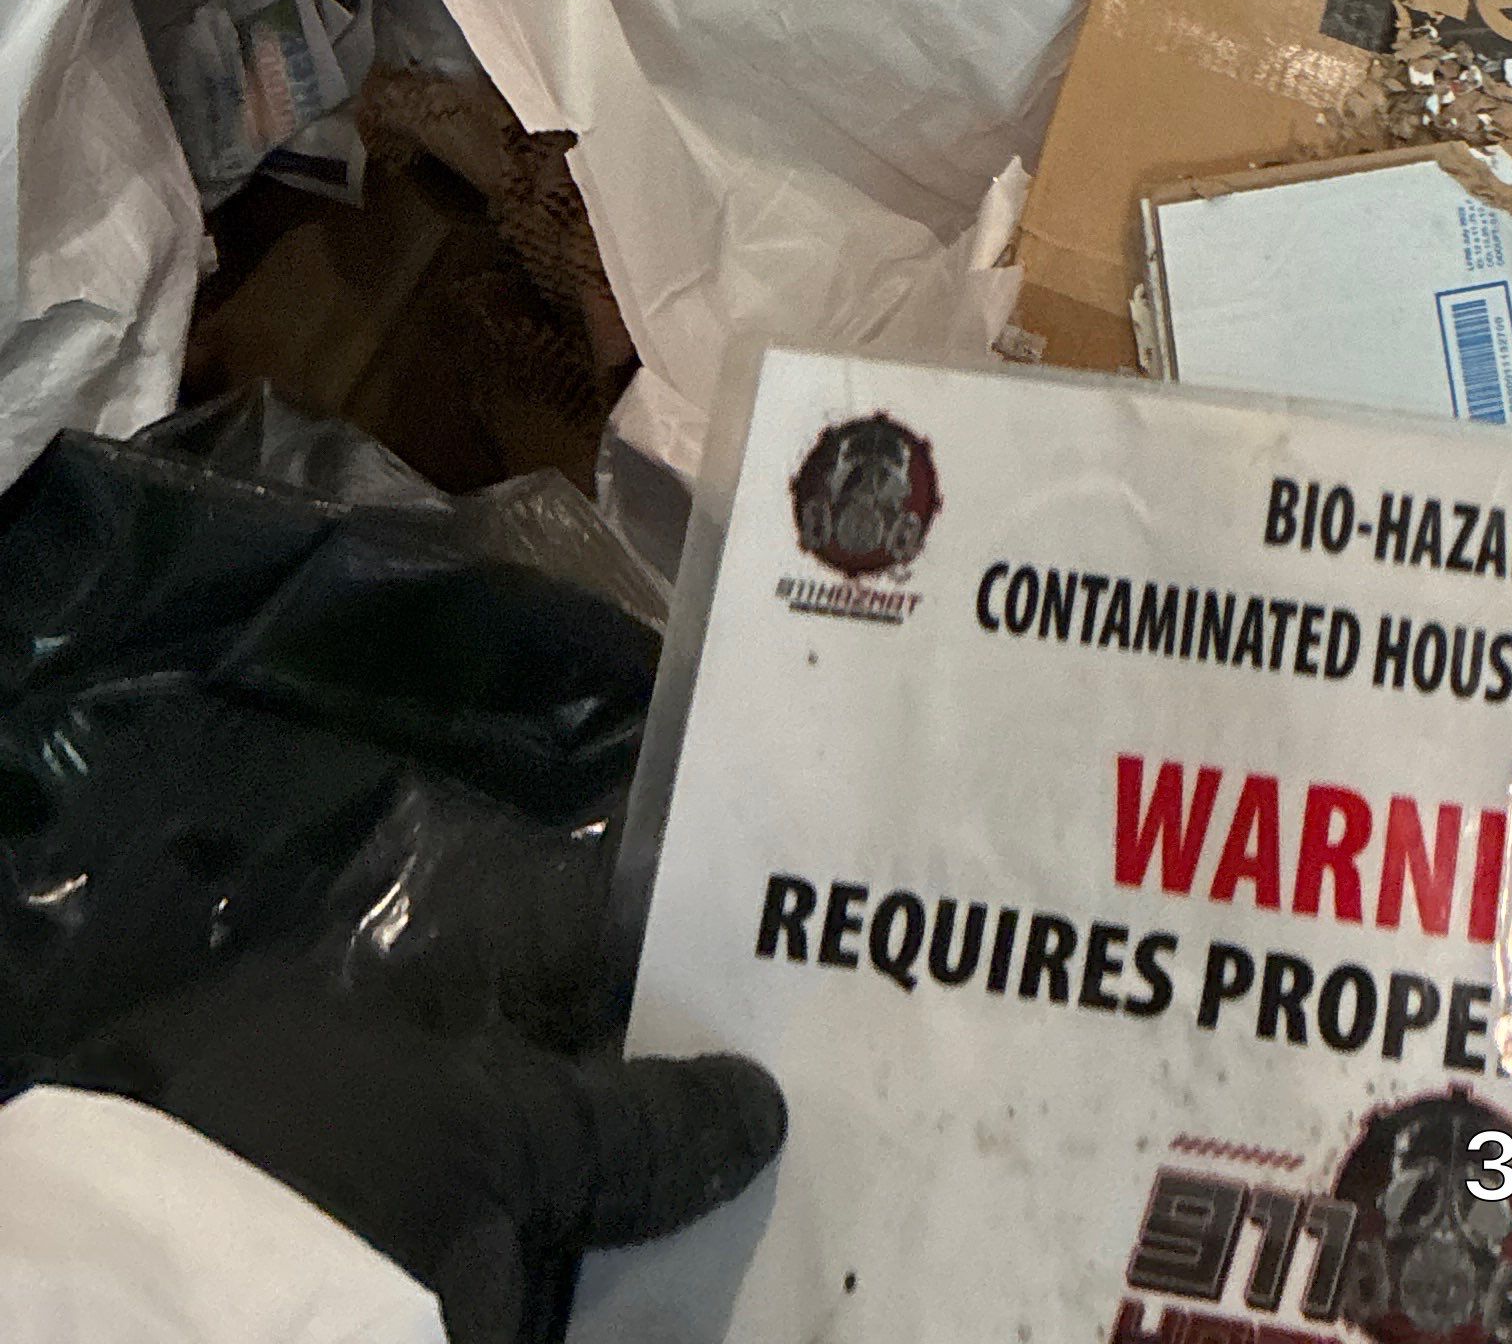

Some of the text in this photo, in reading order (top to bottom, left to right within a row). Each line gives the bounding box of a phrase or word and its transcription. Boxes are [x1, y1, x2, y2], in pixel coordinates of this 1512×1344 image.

[976, 560, 1361, 683] CONTAMINATED
[754, 871, 1180, 1022] REQUIRES
[1124, 1165, 1360, 1326] 911
